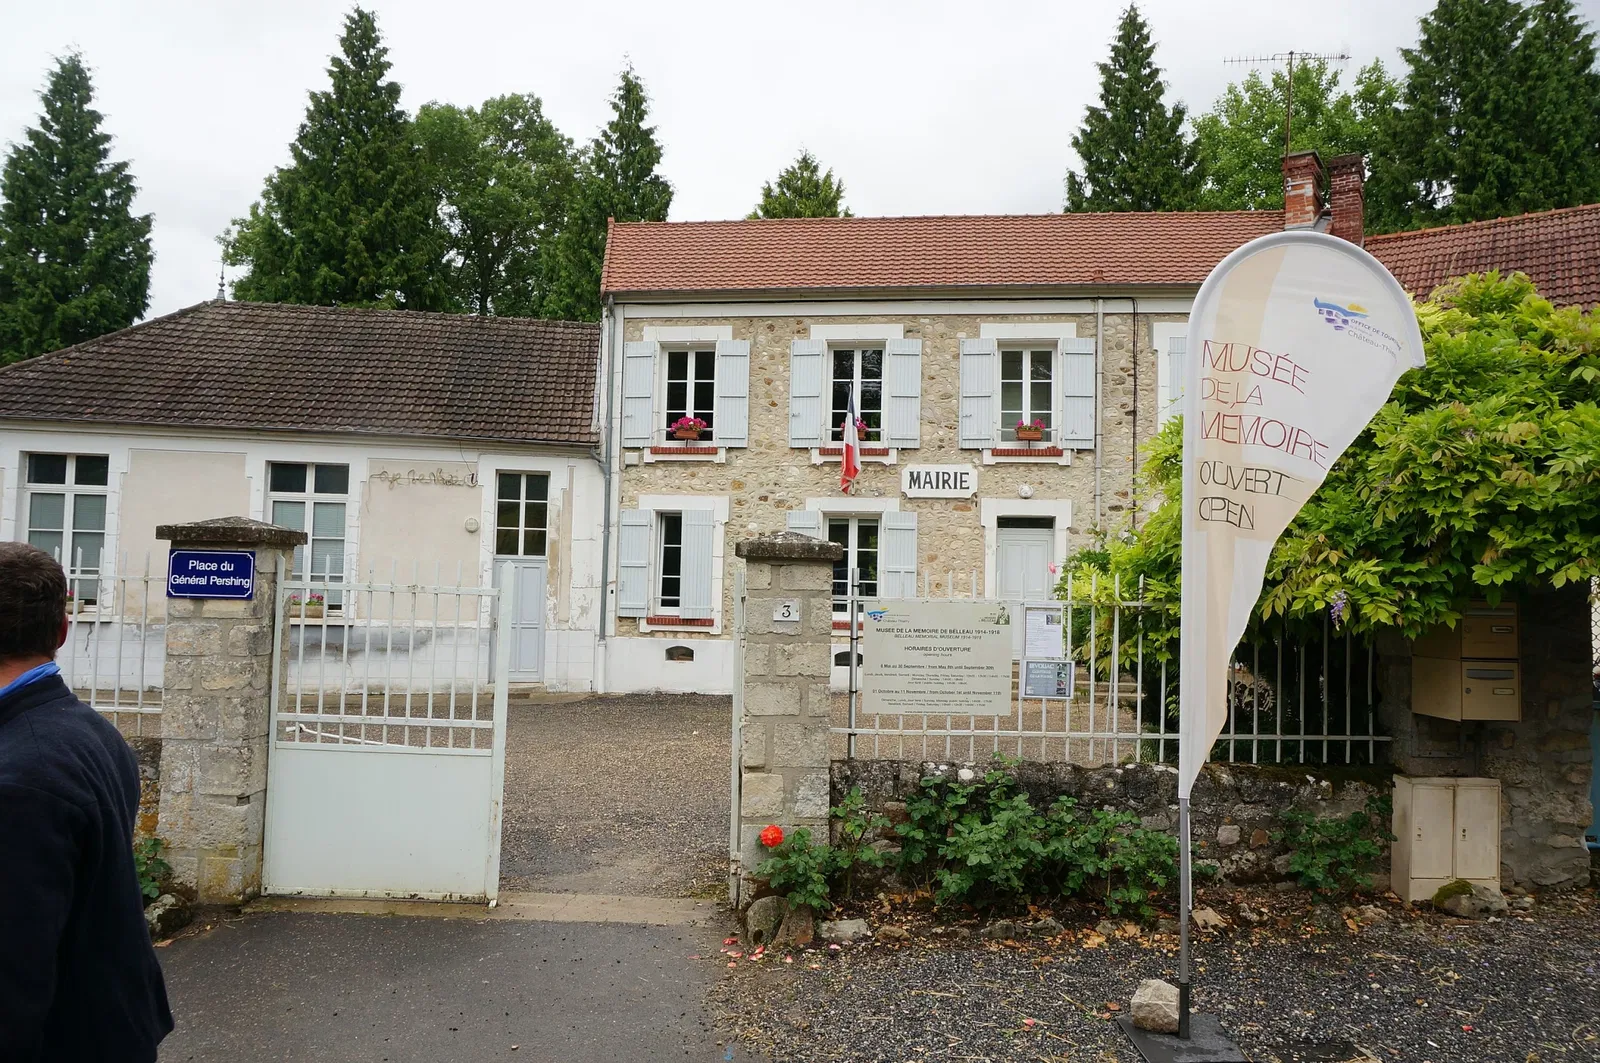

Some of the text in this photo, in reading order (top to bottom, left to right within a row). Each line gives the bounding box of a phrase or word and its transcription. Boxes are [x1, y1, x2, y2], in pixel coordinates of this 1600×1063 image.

[1350, 318, 1371, 331] OFFICE
[1372, 327, 1380, 336] DE
[1202, 339, 1310, 395] MUSÉE
[1201, 378, 1263, 406] DE LA
[908, 470, 970, 490] MAIRIE
[1200, 460, 1291, 495] OUVERT
[1199, 497, 1254, 529] OPEN
[188, 560, 234, 571] Place du
[171, 574, 250, 588] Général Pershing
[782, 604, 791, 618] 3
